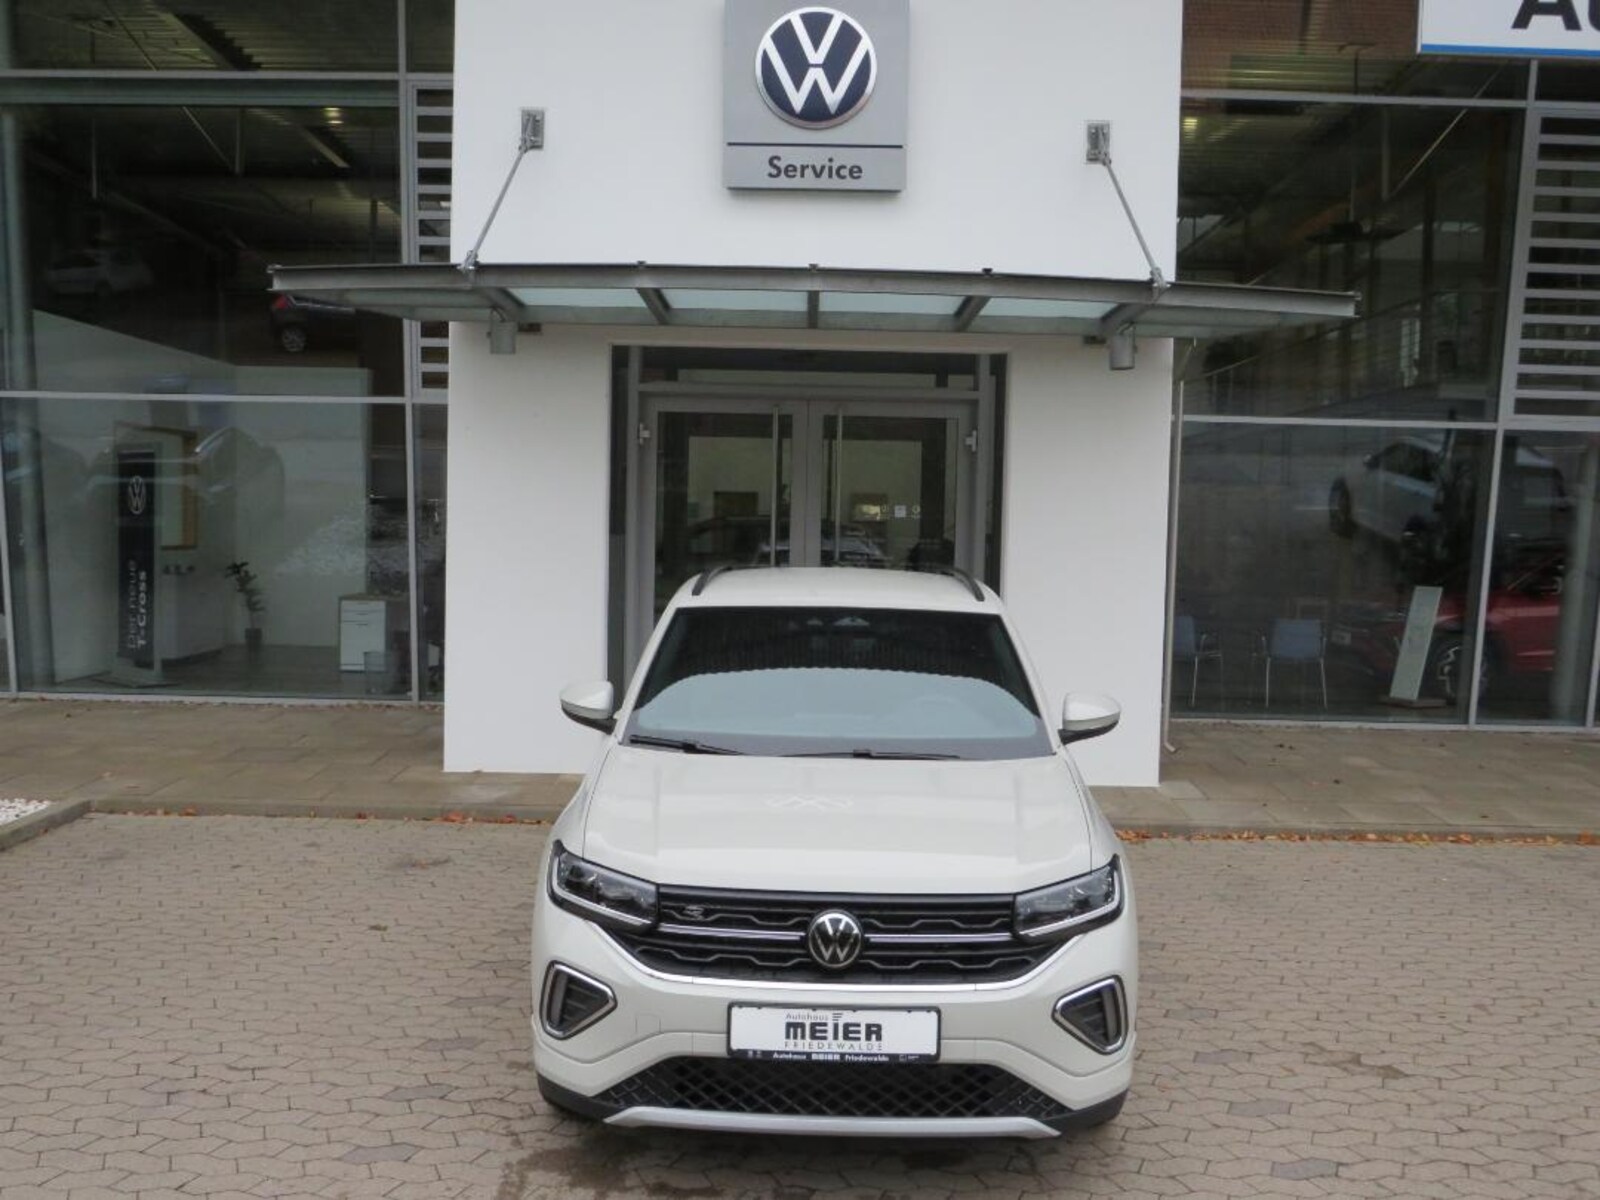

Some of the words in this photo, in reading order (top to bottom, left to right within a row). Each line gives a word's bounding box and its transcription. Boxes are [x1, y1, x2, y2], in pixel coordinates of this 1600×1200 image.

[767, 155, 863, 180] Service
[137, 571, 147, 649] T-Cross
[785, 1012, 829, 1022] Autohaus
[785, 1021, 883, 1042] MEIER
[784, 1041, 883, 1051] FRIEDEWALDE
